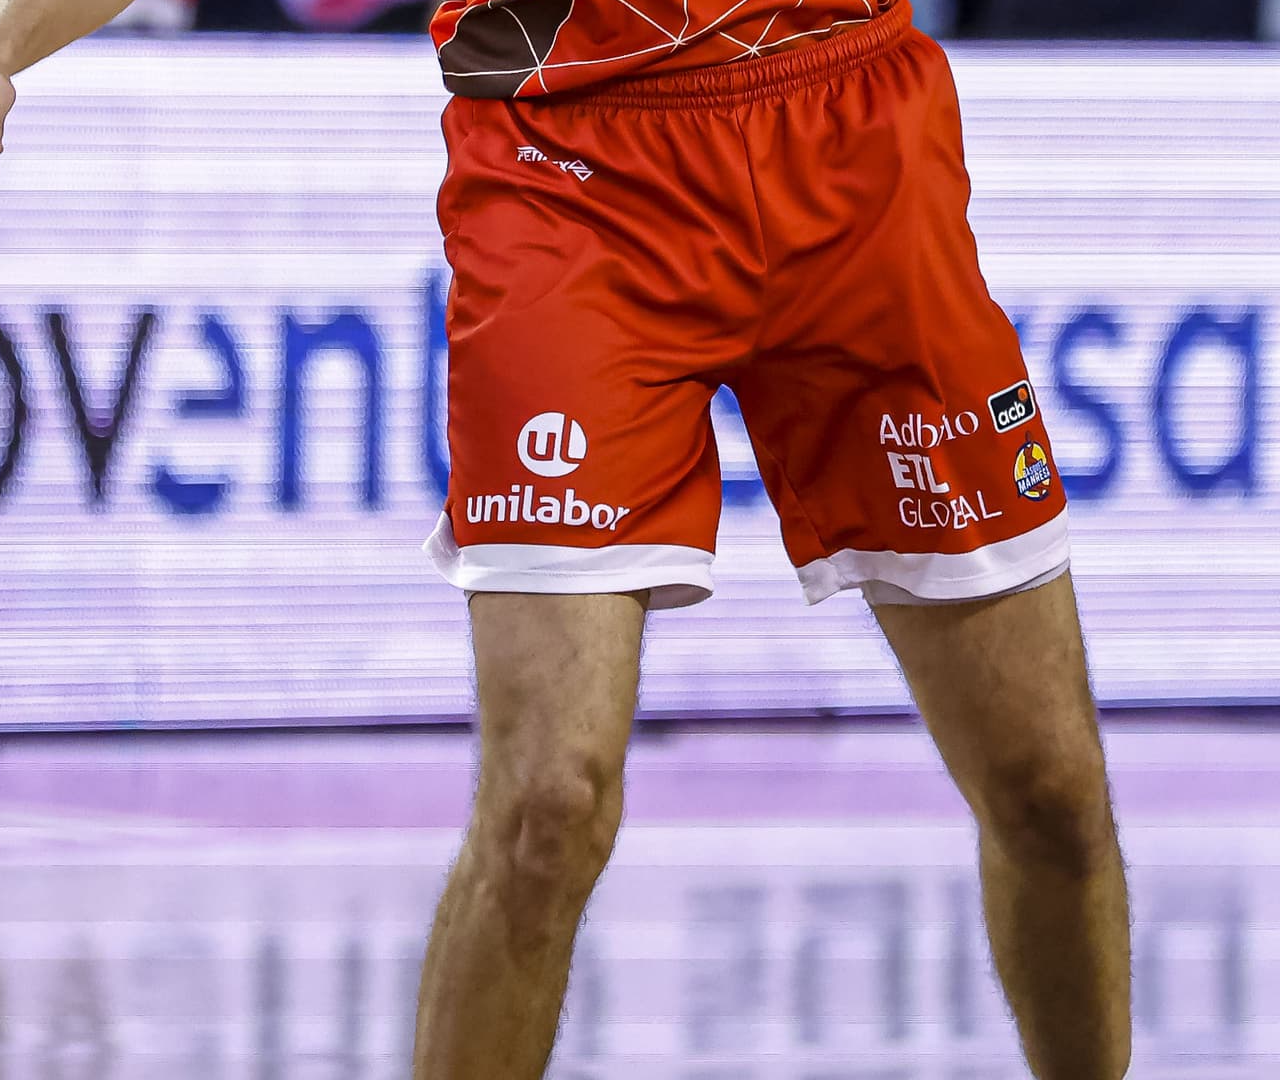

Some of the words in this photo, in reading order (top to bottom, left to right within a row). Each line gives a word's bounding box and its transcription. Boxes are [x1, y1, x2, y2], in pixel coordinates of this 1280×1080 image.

[998, 401, 1026, 427] acb
[887, 452, 950, 493] ETL
[467, 484, 631, 531] unilabor
[899, 490, 1003, 529] GLOBAL
